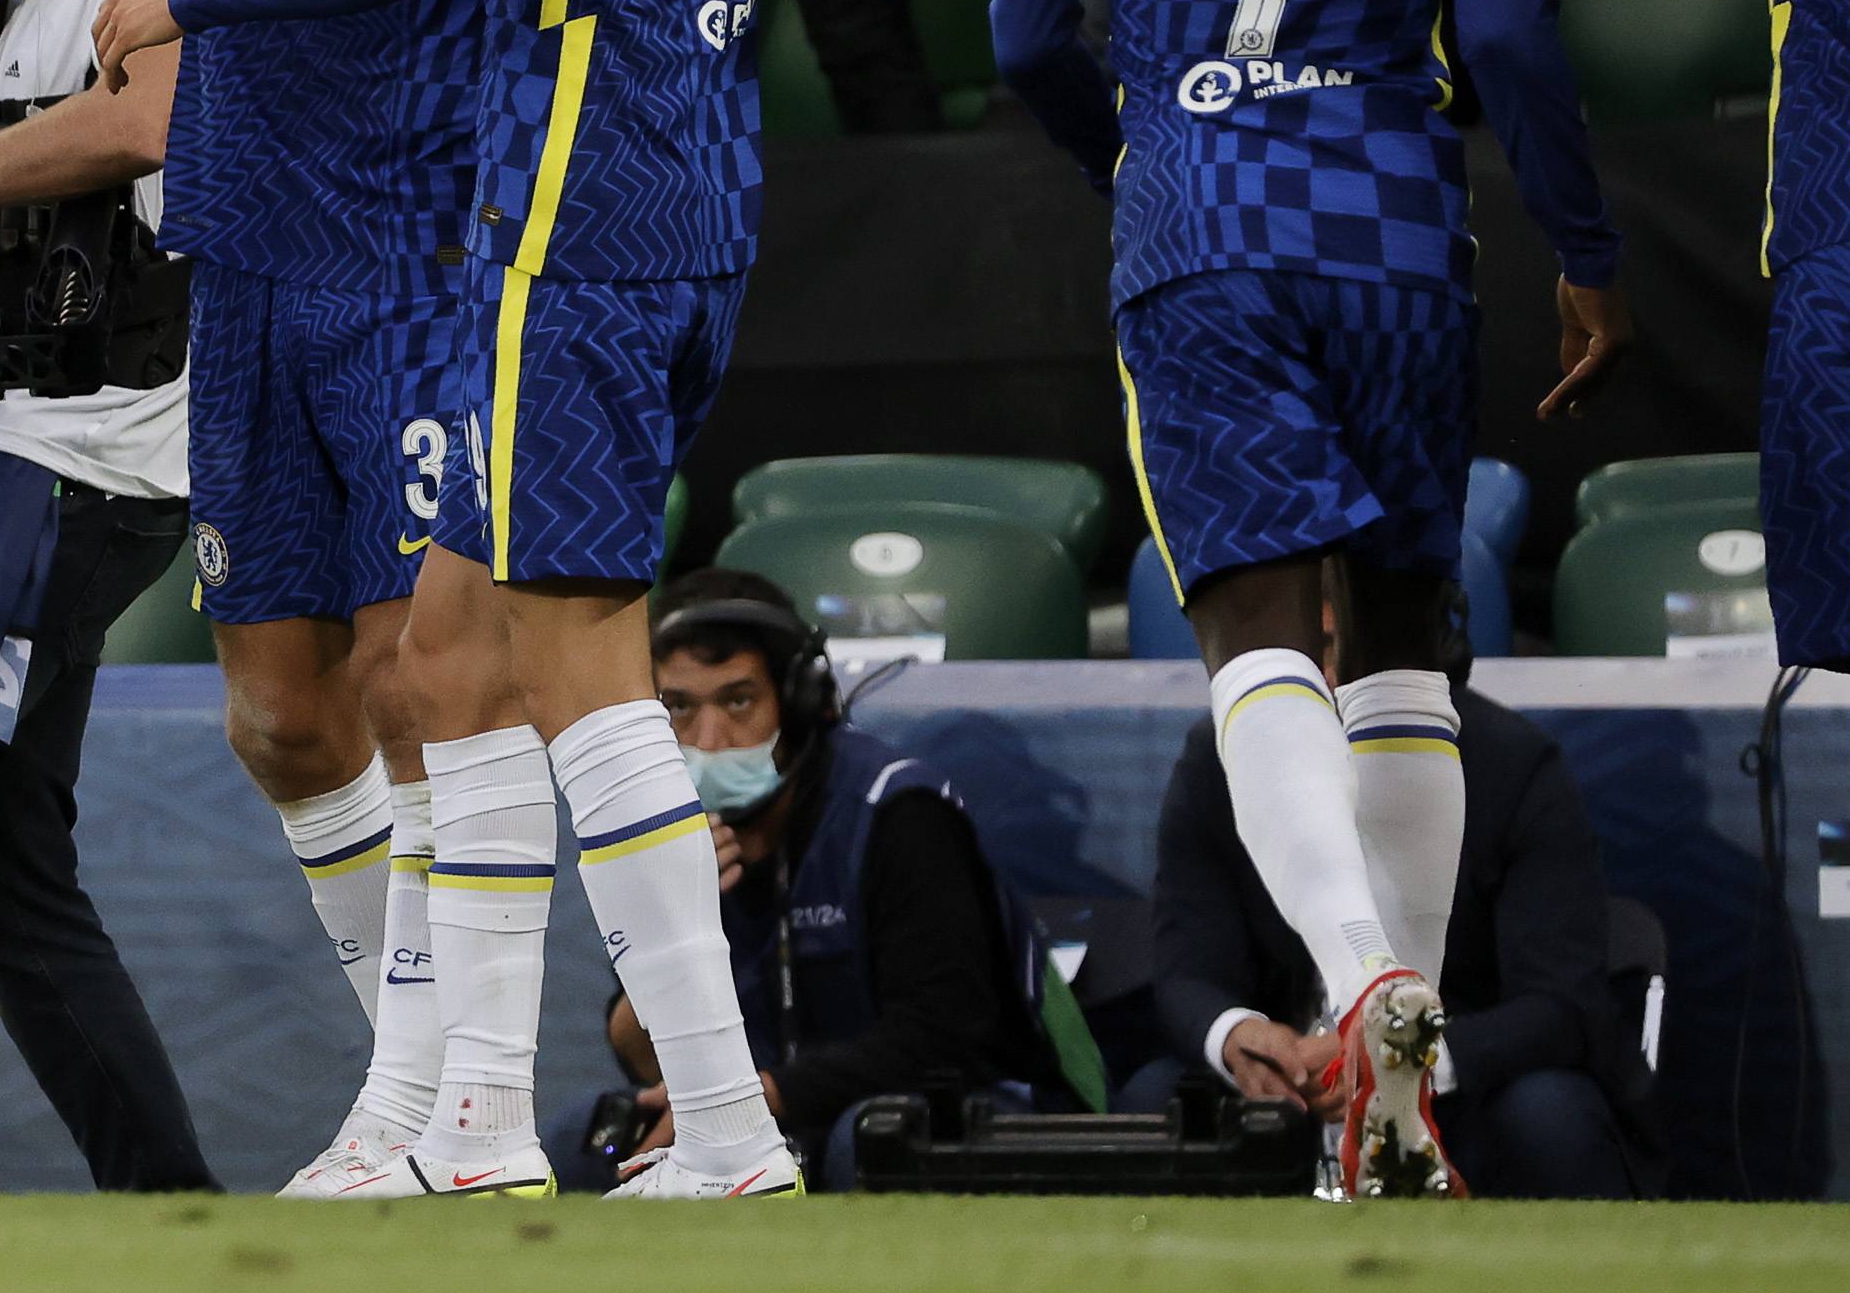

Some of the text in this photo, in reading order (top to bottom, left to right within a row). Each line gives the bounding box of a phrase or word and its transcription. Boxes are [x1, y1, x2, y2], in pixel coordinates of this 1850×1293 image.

[1247, 60, 1354, 87] PLAN
[402, 419, 448, 520] 3
[394, 948, 432, 967] CF
